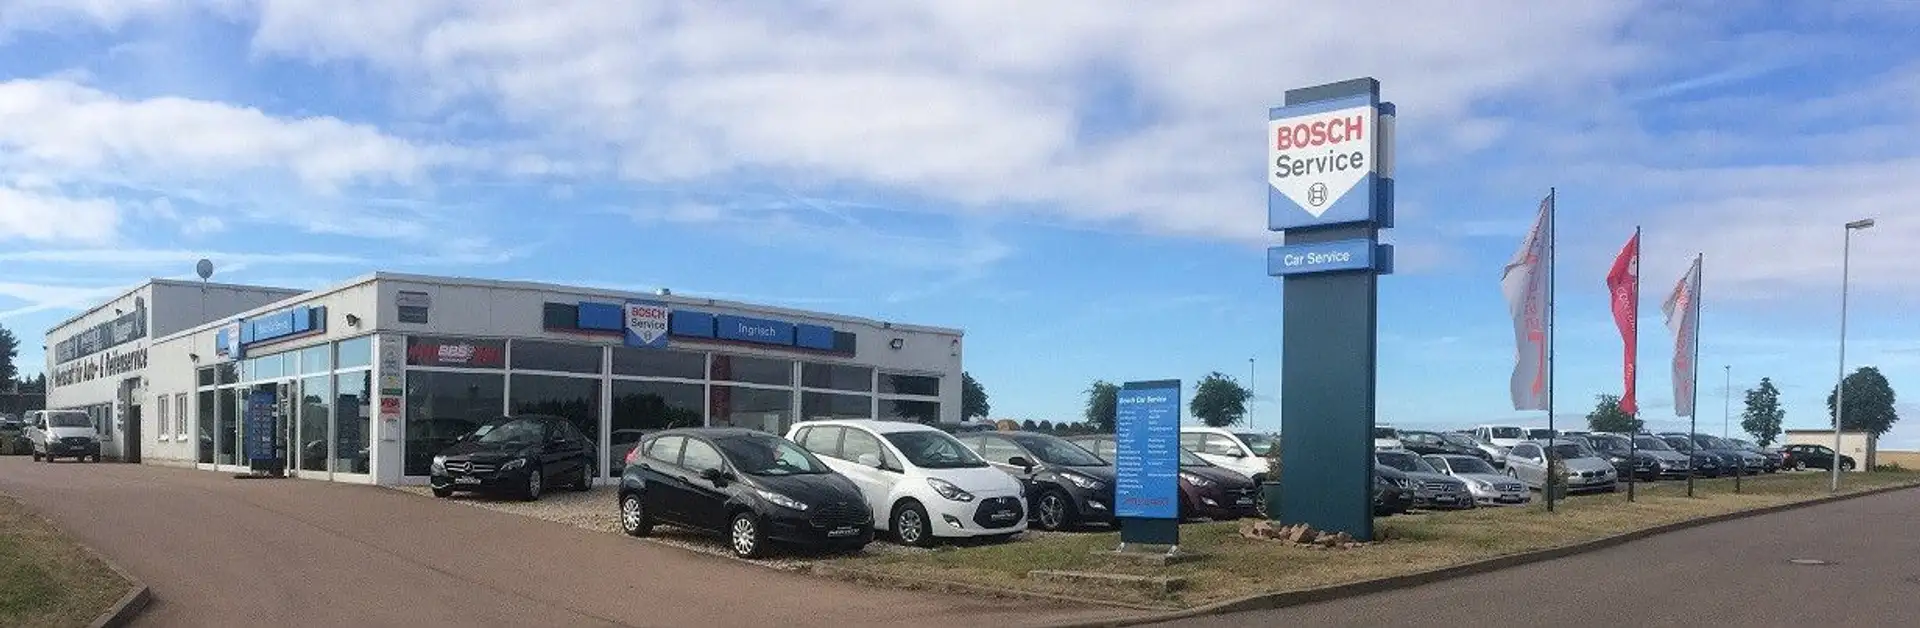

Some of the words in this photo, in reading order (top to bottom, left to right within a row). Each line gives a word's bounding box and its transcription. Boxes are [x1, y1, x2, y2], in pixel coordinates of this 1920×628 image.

[1277, 115, 1363, 150] BOSCH
[1276, 150, 1363, 178] Service
[1284, 254, 1303, 266] Car
[1307, 250, 1350, 264] Service
[631, 307, 665, 319] BOSCH
[631, 318, 665, 330] Service
[738, 322, 776, 337] Ingrisch
[106, 349, 147, 377] Reifenservice
[1147, 395, 1167, 403] Service
